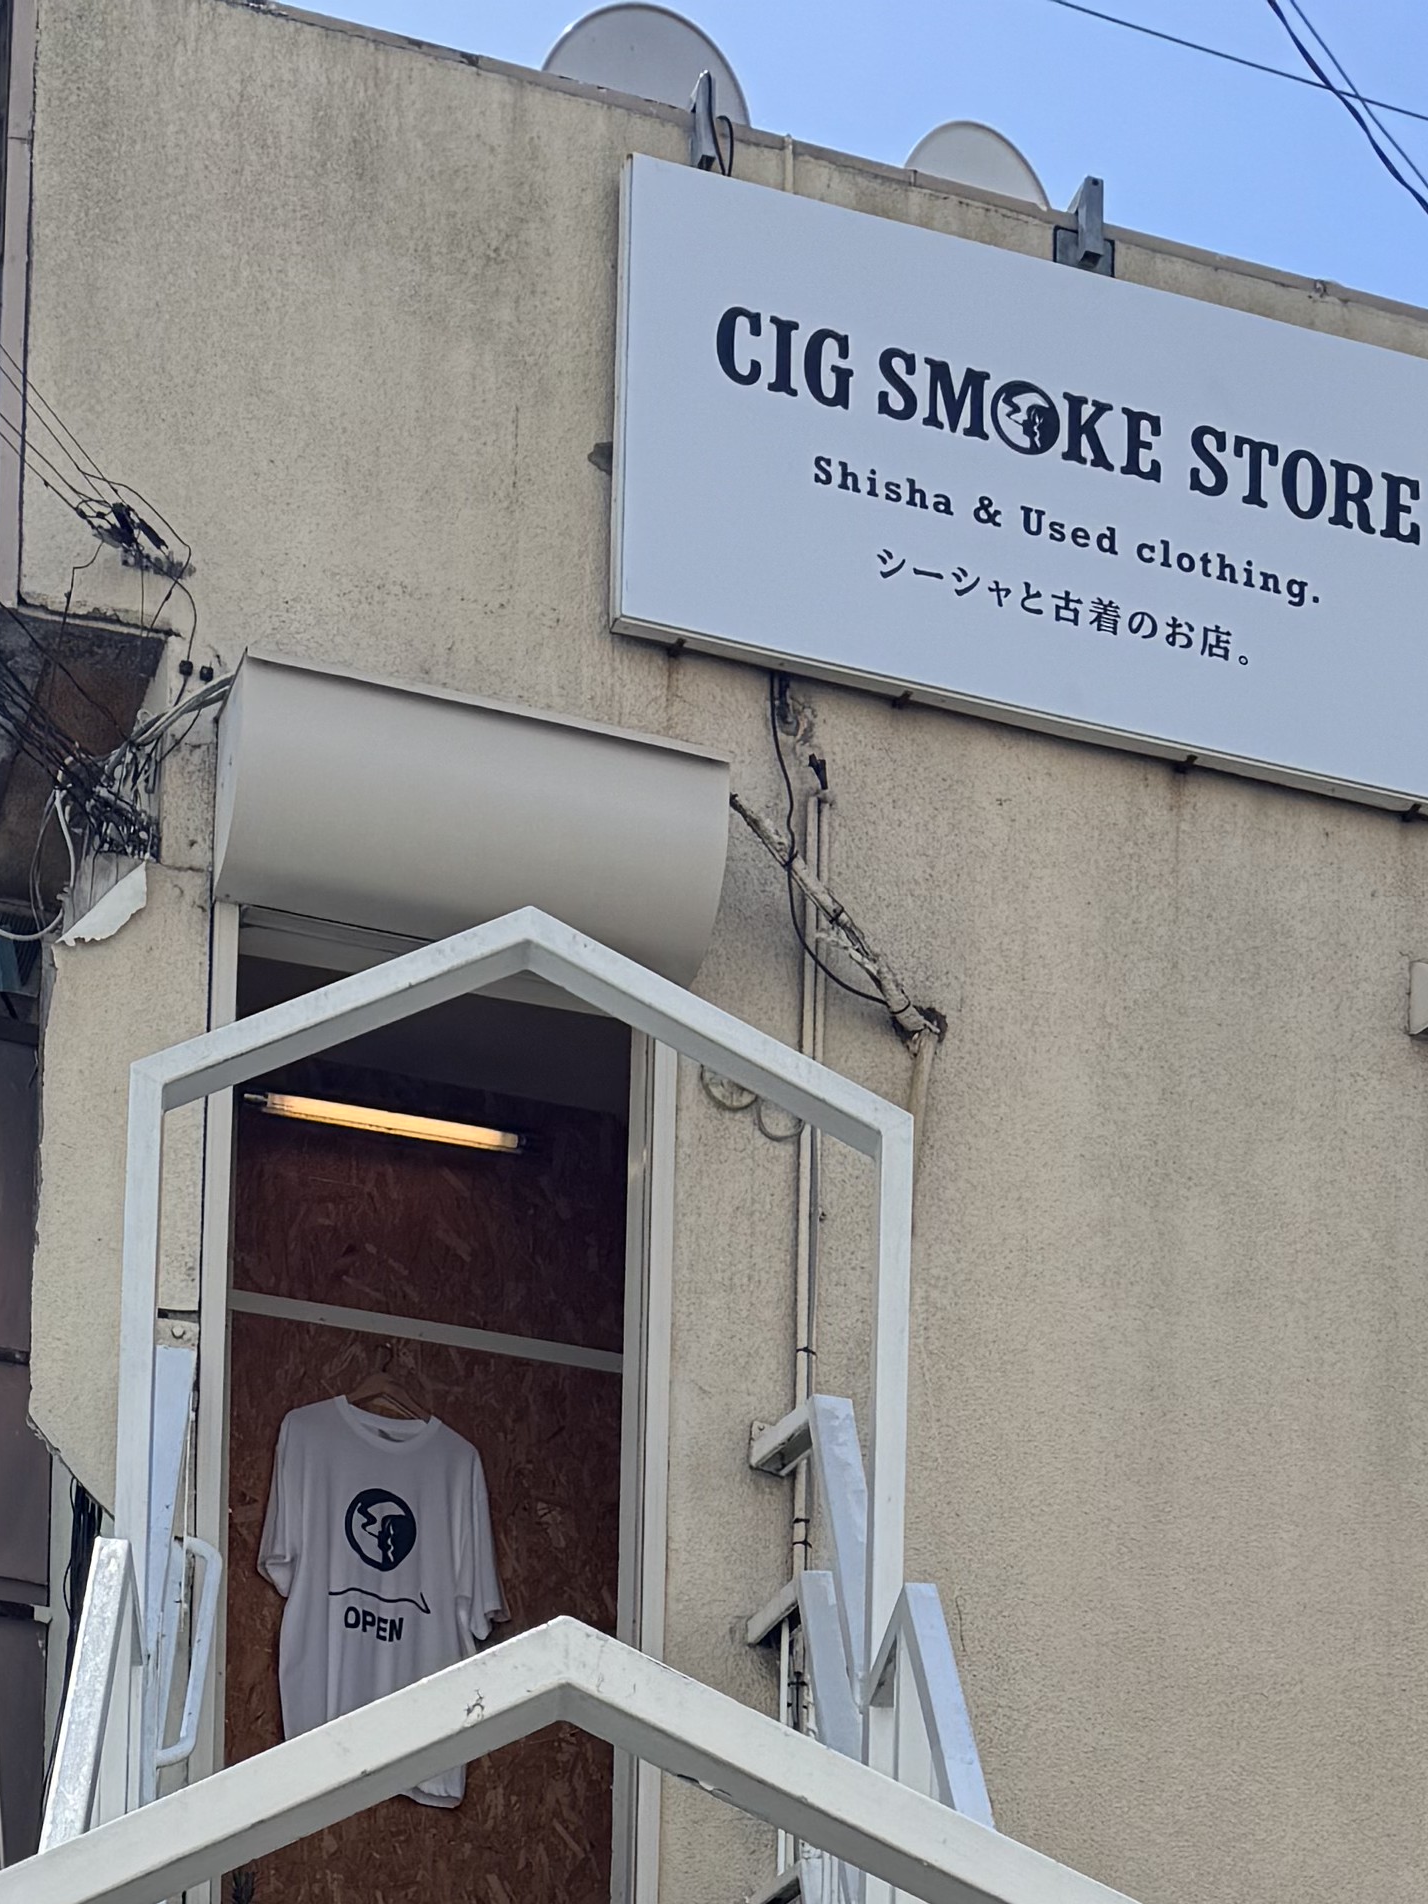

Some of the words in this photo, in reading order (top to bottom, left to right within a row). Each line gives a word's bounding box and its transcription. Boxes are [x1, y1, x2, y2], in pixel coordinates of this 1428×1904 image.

[716, 306, 855, 411] CIG
[877, 347, 1162, 484] SMOKE
[1189, 424, 1422, 546] STORE
[814, 455, 954, 516] Shisha
[973, 495, 1002, 528] &
[1019, 505, 1119, 556] Used
[1136, 539, 1321, 605] clothing.
[876, 547, 1252, 667] シーシャと古着のお店。
[343, 1606, 404, 1643] OPEN
